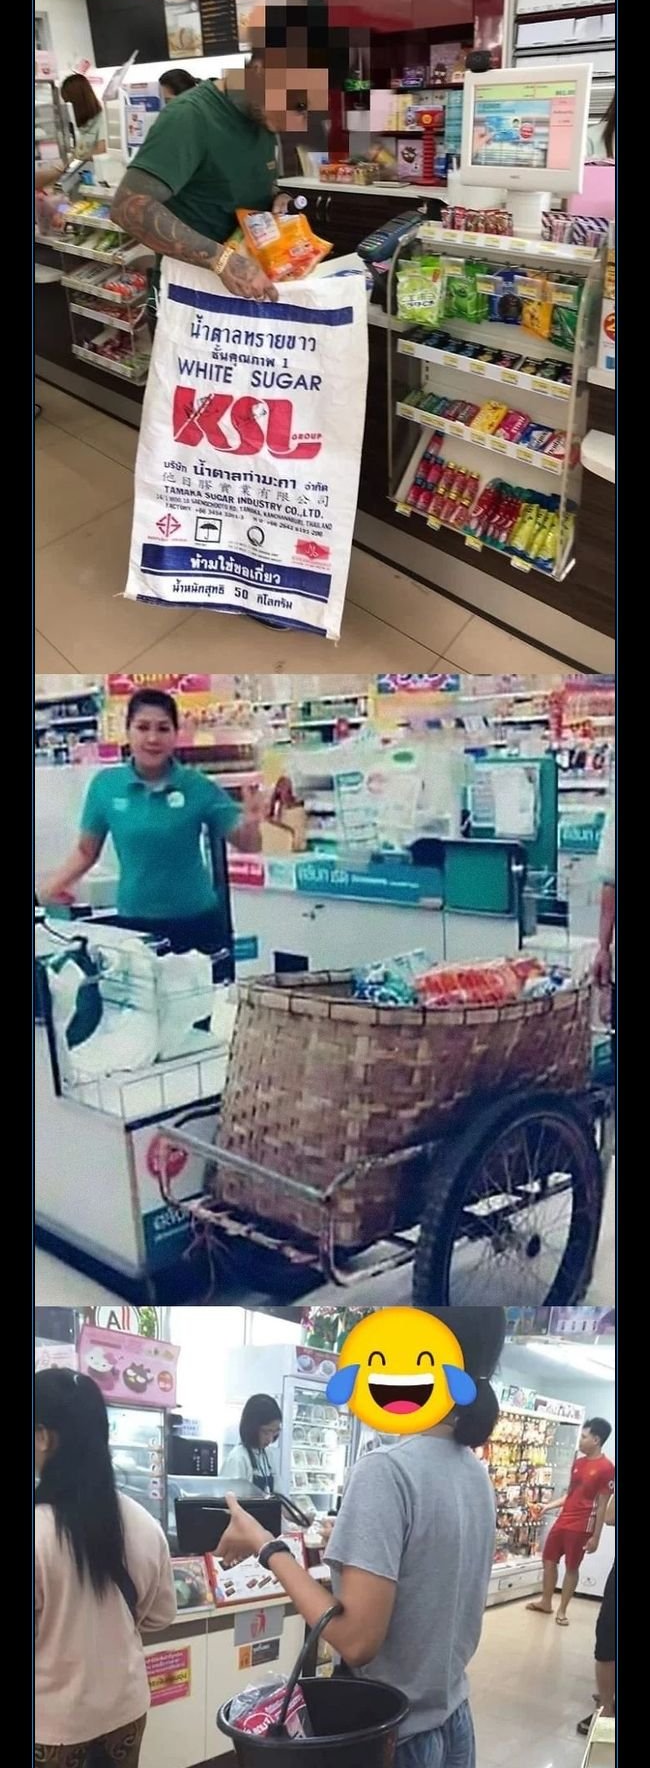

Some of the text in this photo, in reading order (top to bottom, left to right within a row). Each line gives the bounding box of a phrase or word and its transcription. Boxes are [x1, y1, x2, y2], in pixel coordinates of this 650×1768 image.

[190, 315, 316, 352] น้ำตาลทรายขาว
[177, 357, 322, 392] WHITE SUGAR
[211, 345, 288, 369] ชั้นคุณภาพ 1
[173, 385, 322, 459] KSL GROUP
[164, 485, 324, 520] TAMAKA SUGAR INDUSTRY CO.,LTD.
[234, 587, 249, 600] 50
[257, 593, 293, 610] กิโลกรัม
